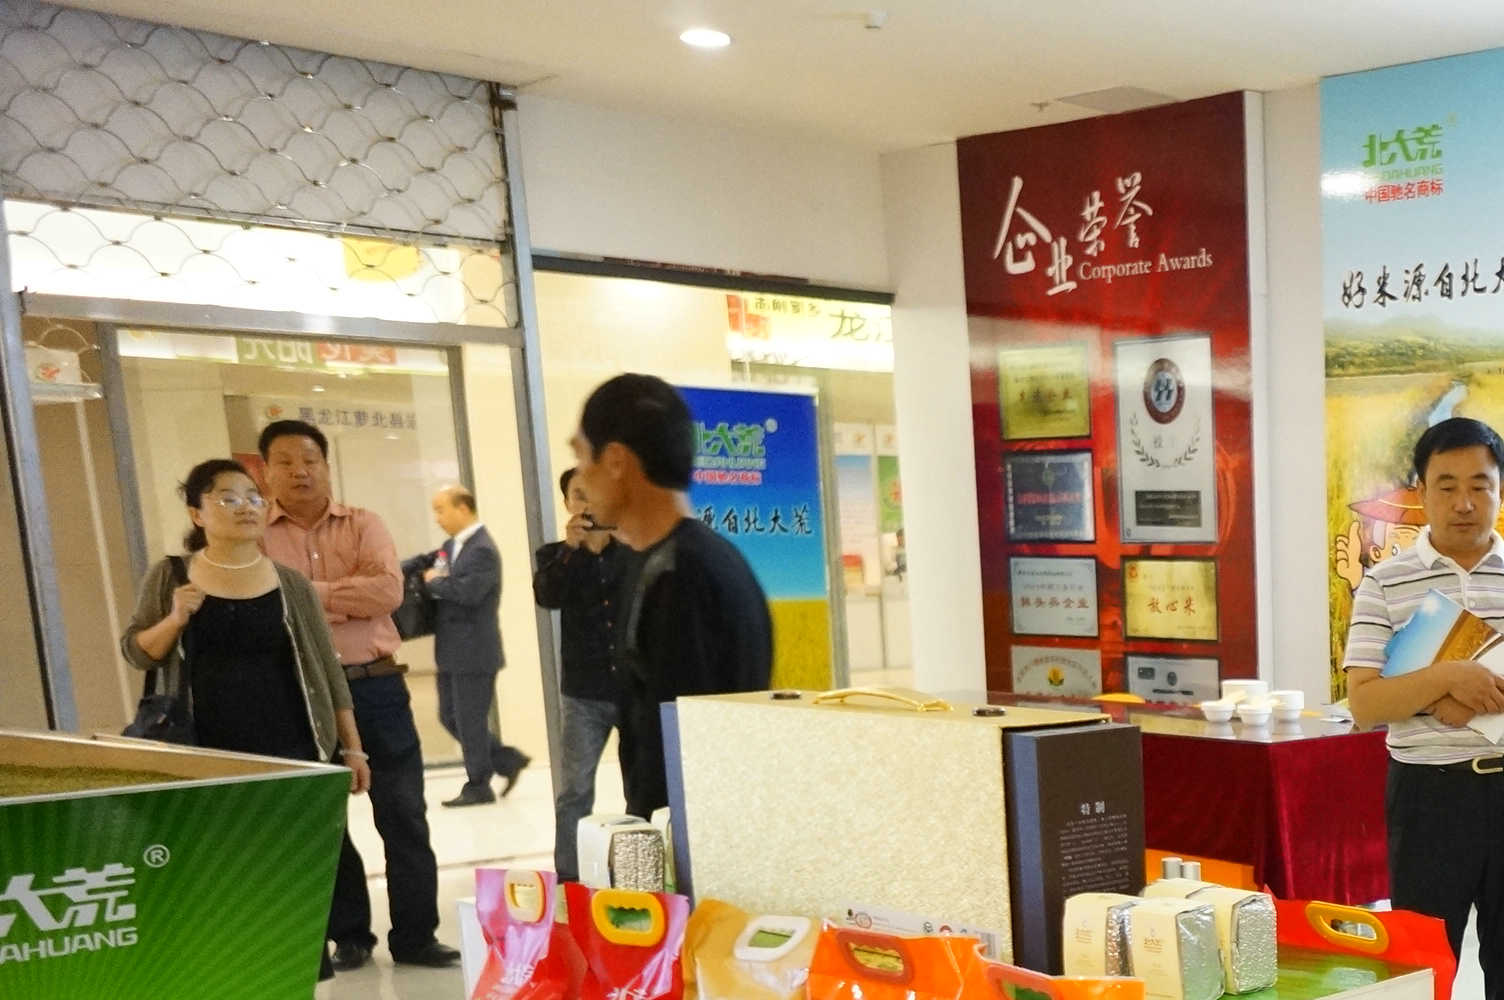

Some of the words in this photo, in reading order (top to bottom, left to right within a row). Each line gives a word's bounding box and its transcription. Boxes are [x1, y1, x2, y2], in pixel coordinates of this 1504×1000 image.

[1362, 124, 1443, 168] 北大荒
[1364, 179, 1444, 204] 中国驰名商标
[994, 172, 1153, 295] 企业荣誉
[1079, 260, 1152, 284] Corporate
[1157, 248, 1213, 272] Awards
